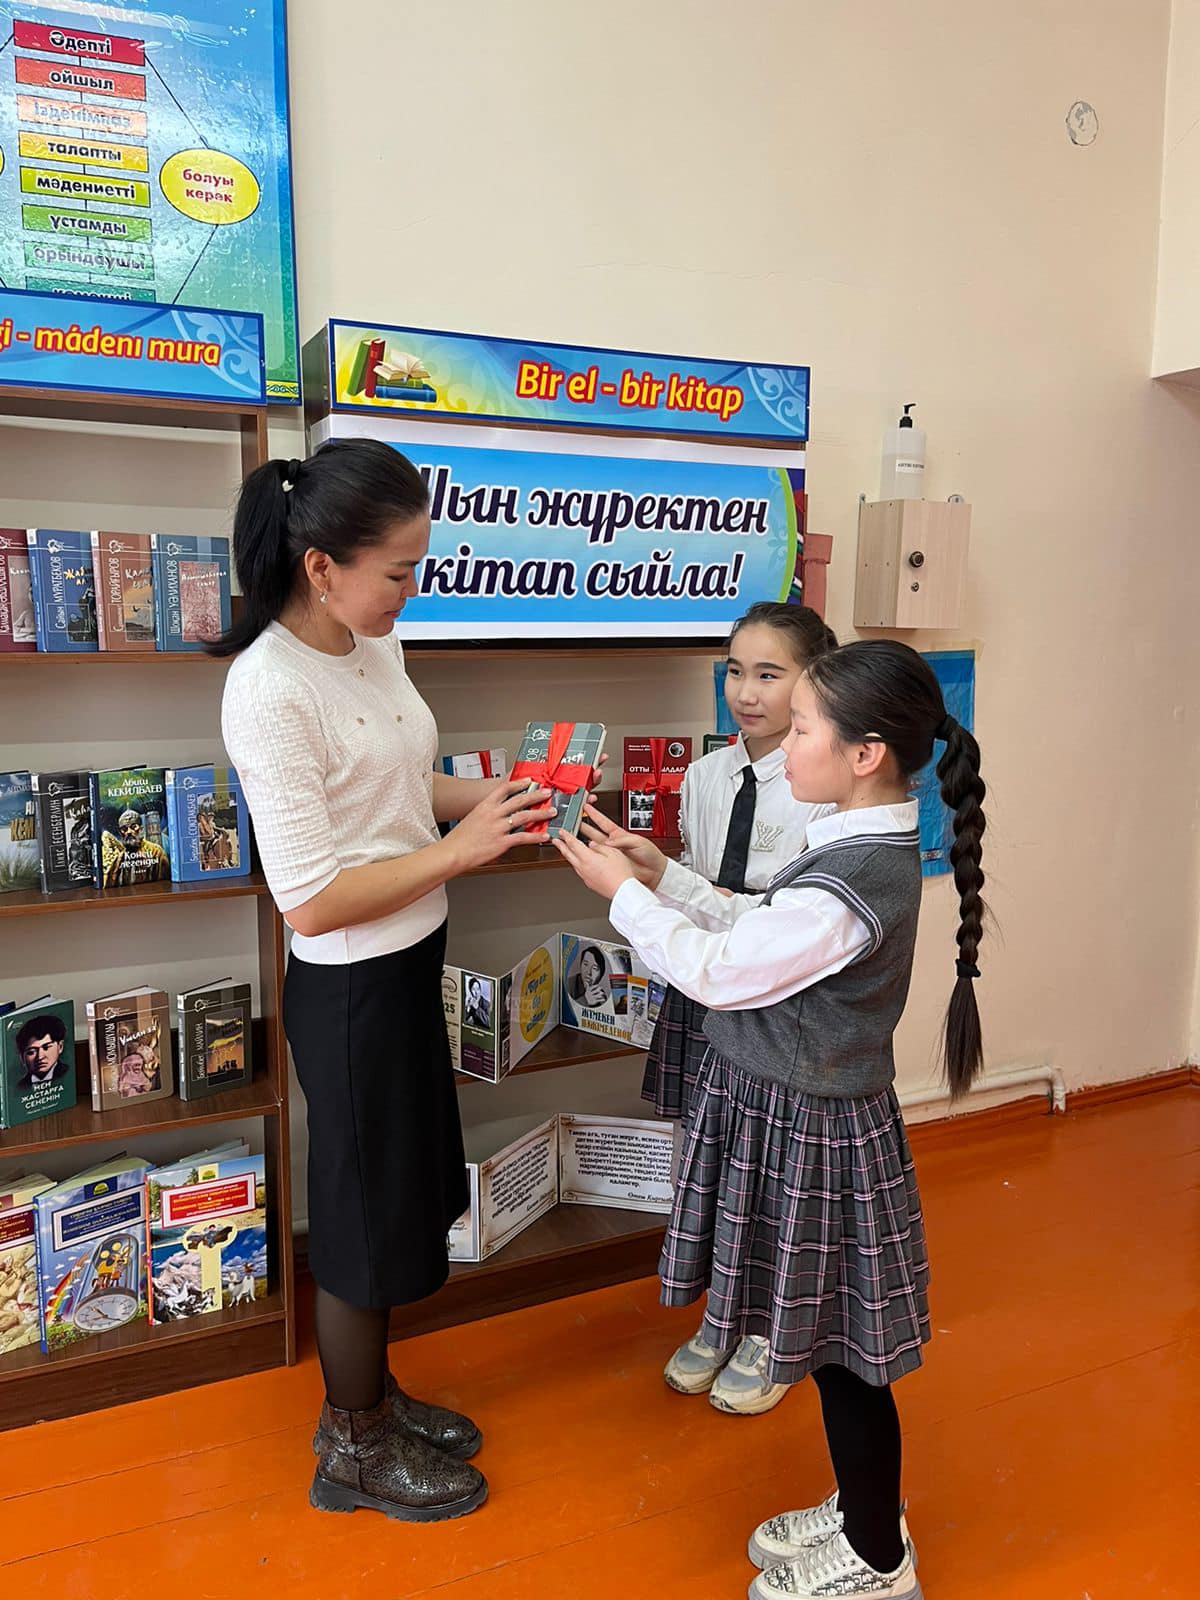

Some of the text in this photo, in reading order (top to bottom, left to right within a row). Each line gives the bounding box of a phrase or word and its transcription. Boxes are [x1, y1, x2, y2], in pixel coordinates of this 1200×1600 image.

[50, 31, 112, 55] Әдепті
[50, 70, 114, 91] ойшыл
[47, 140, 122, 162] талапты
[37, 176, 136, 199] мәдениетті
[182, 168, 234, 187] болуы
[34, 247, 145, 272] орындаушы
[148, 335, 221, 366] mura
[517, 360, 564, 399] Bir
[567, 366, 599, 403] el
[619, 368, 663, 409] bir
[667, 371, 745, 422] kitap
[526, 490, 769, 544] жүректен
[419, 544, 745, 598] кітап сыйла!
[107, 784, 163, 798] КЕКИЛБАЕВ
[122, 778, 149, 787] Абиш
